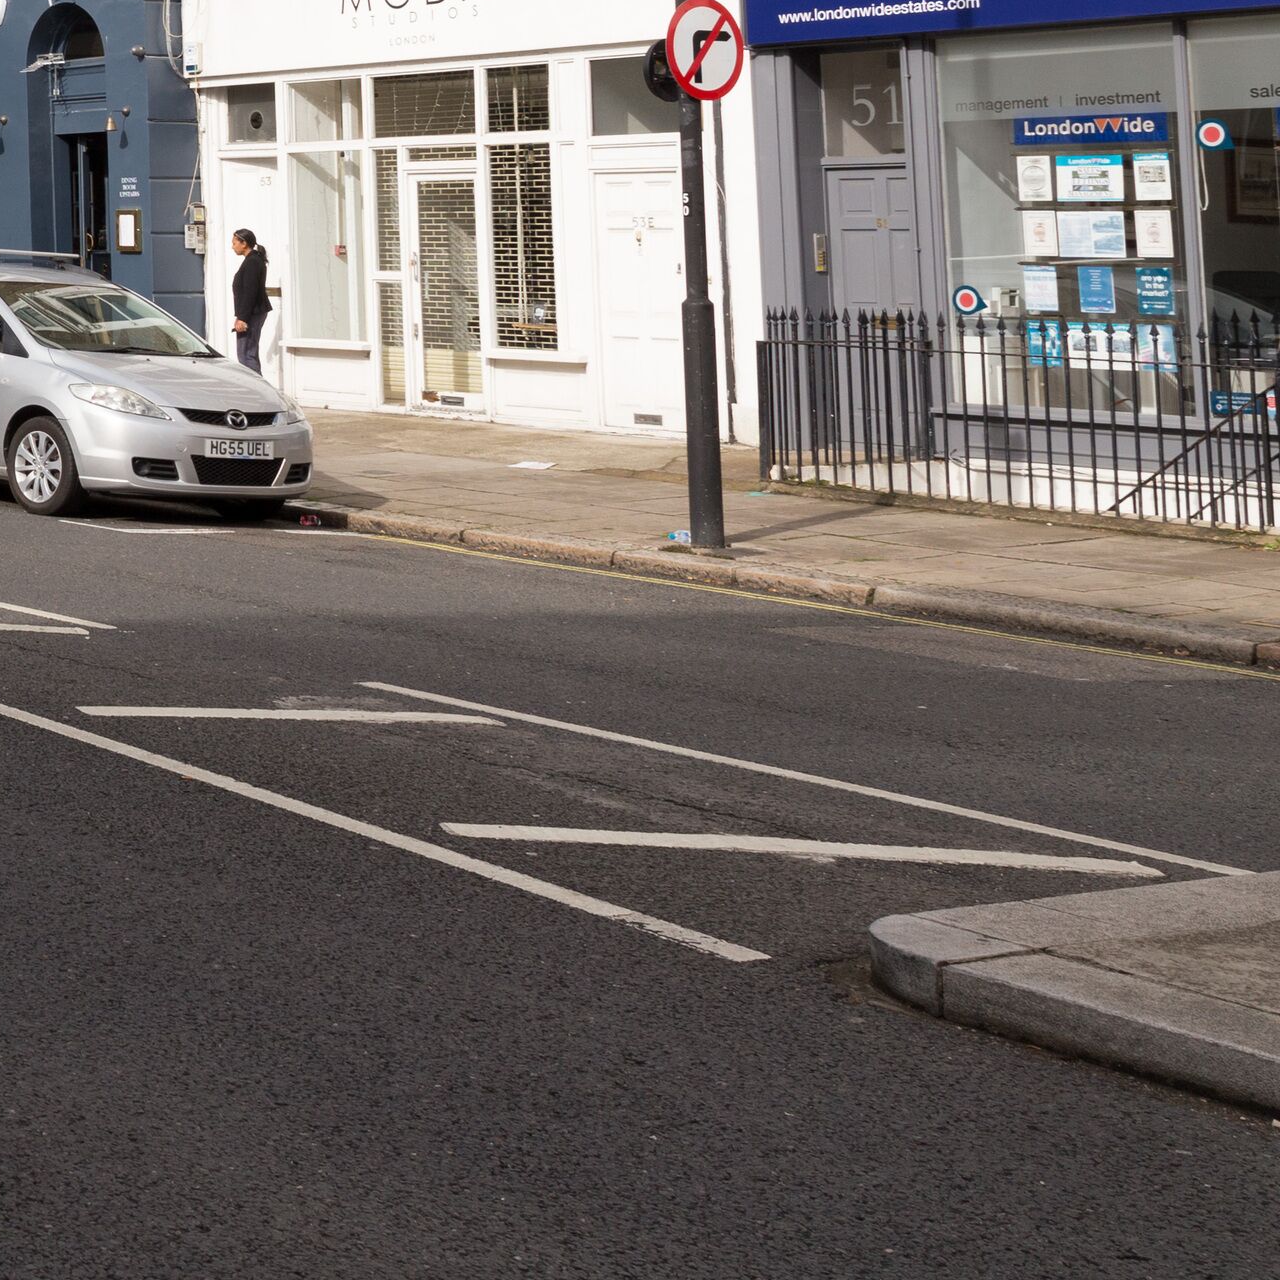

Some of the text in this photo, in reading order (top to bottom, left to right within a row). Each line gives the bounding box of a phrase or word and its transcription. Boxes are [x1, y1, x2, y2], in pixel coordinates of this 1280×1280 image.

[351, 5, 479, 29] STUDIOS
[389, 34, 436, 47] LONDON
[851, 84, 904, 127] 51
[955, 90, 1161, 113] management investment
[1023, 118, 1155, 137] LondonWide
[260, 177, 272, 187] 53
[1152, 276, 1168, 284] you
[210, 440, 269, 457] HG55 UEL
